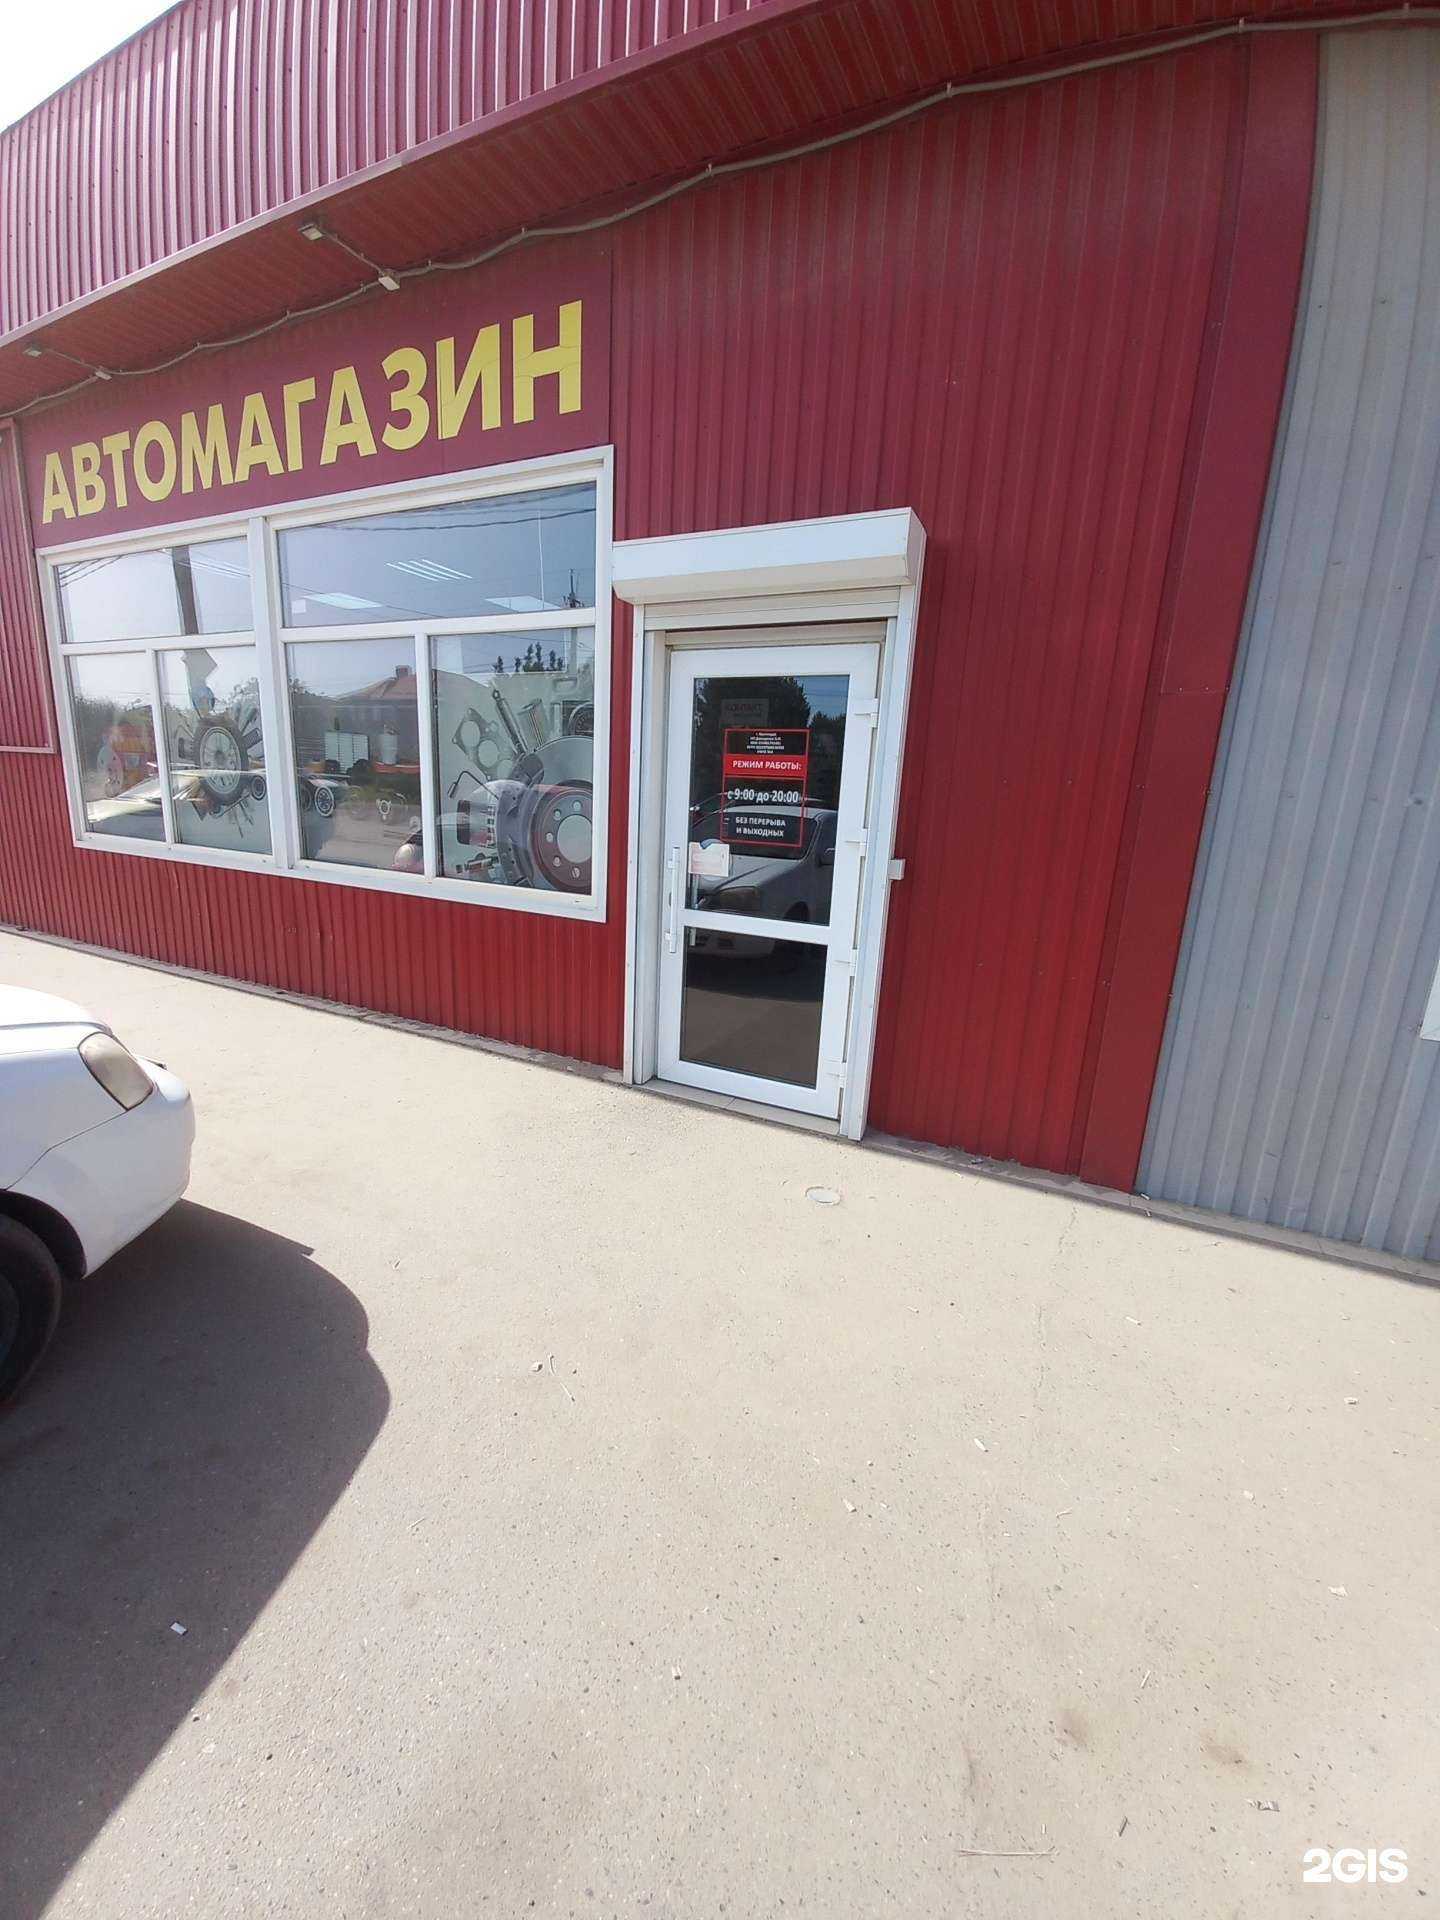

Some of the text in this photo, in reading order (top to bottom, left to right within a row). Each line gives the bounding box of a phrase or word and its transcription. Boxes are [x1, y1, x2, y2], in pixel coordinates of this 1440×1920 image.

[42, 300, 582, 524] АВТОМАГАЗИН
[733, 760, 801, 770] РЕЖИМ РАБОТЫ:
[727, 788, 799, 803] с 9:00 до 20:00
[749, 818, 786, 826] ПЕРЕРЫВА
[743, 828, 784, 837] ВЫХОДНЫХ
